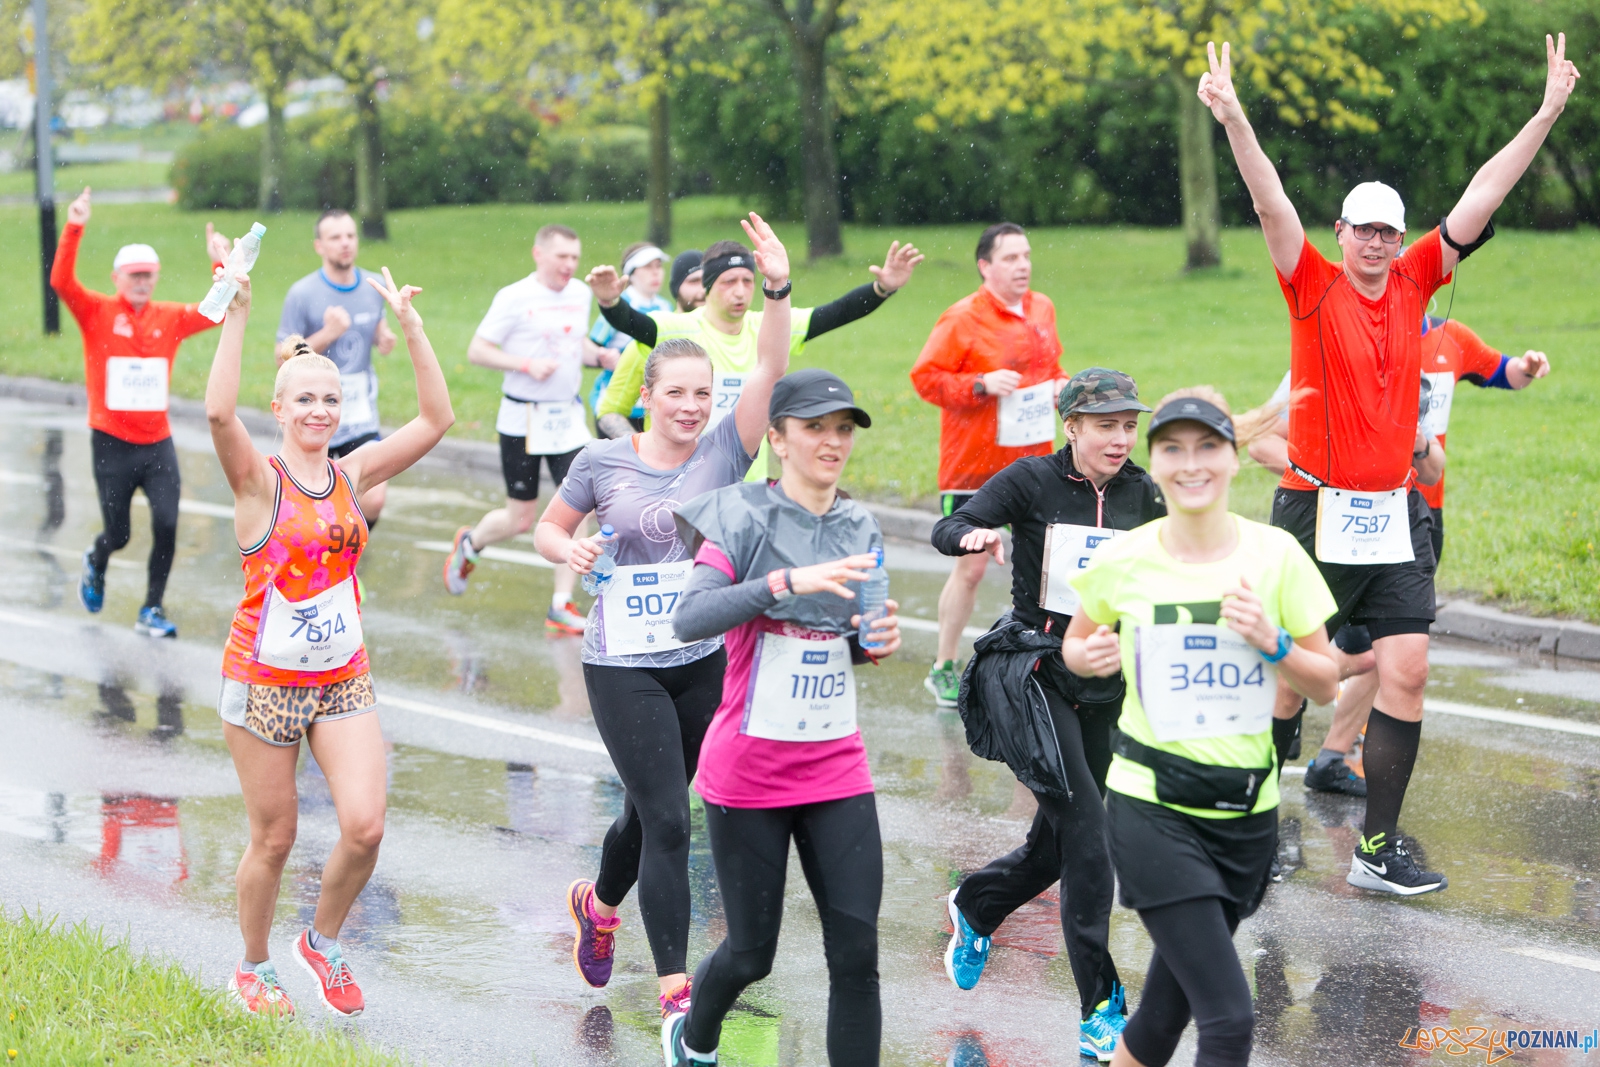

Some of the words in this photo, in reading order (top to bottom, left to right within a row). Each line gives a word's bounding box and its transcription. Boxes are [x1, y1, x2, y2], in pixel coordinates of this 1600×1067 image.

[1341, 514, 1391, 534] 7587
[328, 524, 360, 554] 94
[636, 575, 655, 583] 9.PKO
[626, 591, 683, 617] 907
[289, 612, 346, 643] 7674
[791, 671, 845, 698] 11103
[1170, 662, 1265, 691] 3404
